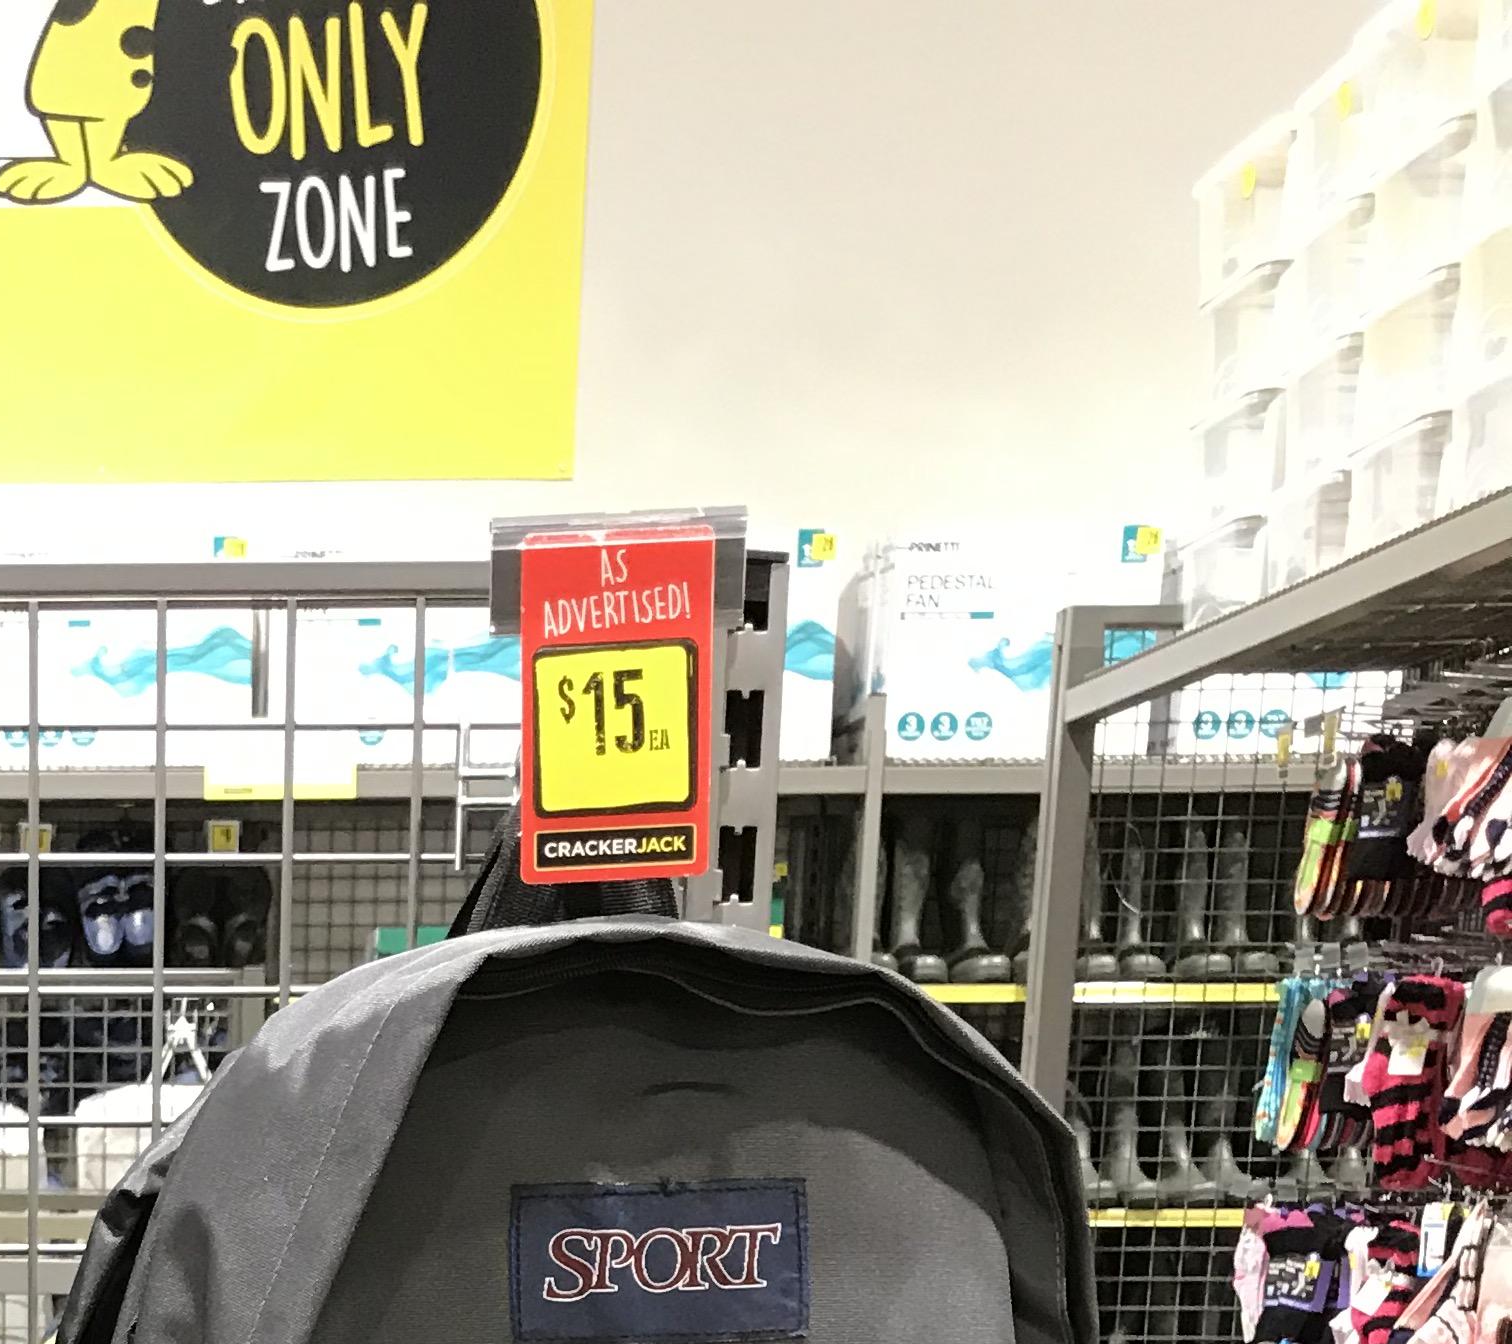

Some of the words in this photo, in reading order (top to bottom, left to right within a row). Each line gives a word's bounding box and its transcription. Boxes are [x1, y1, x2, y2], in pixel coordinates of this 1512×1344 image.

[230, 2, 427, 160] ONLY
[259, 168, 413, 272] ZONE
[600, 548, 628, 587] AS
[907, 573, 995, 590] PEDESTAL
[544, 581, 691, 639] ADVERTISED!
[906, 594, 940, 608] FAN
[649, 729, 671, 751] EA
[544, 835, 687, 858] CRACKERJACK
[543, 1222, 782, 1302] SPORT
